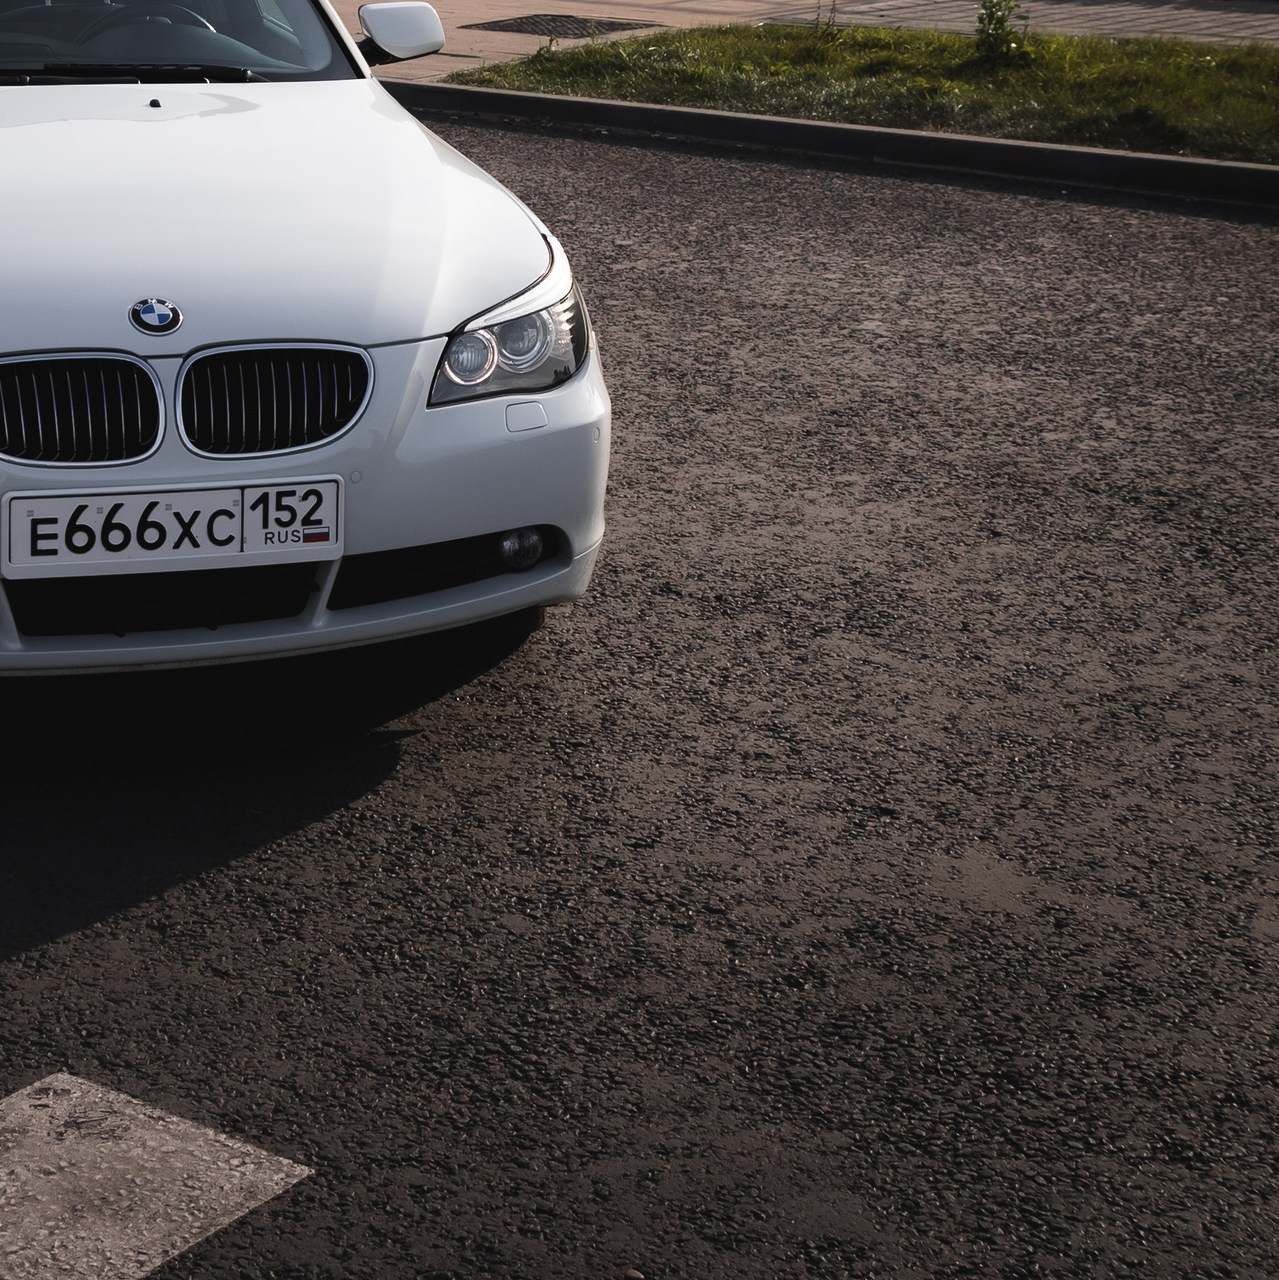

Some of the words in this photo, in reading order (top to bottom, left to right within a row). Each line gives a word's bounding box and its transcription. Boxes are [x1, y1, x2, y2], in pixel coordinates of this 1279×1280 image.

[134, 298, 175, 310] BMW
[250, 489, 324, 529] 152
[265, 530, 302, 545] RUS
